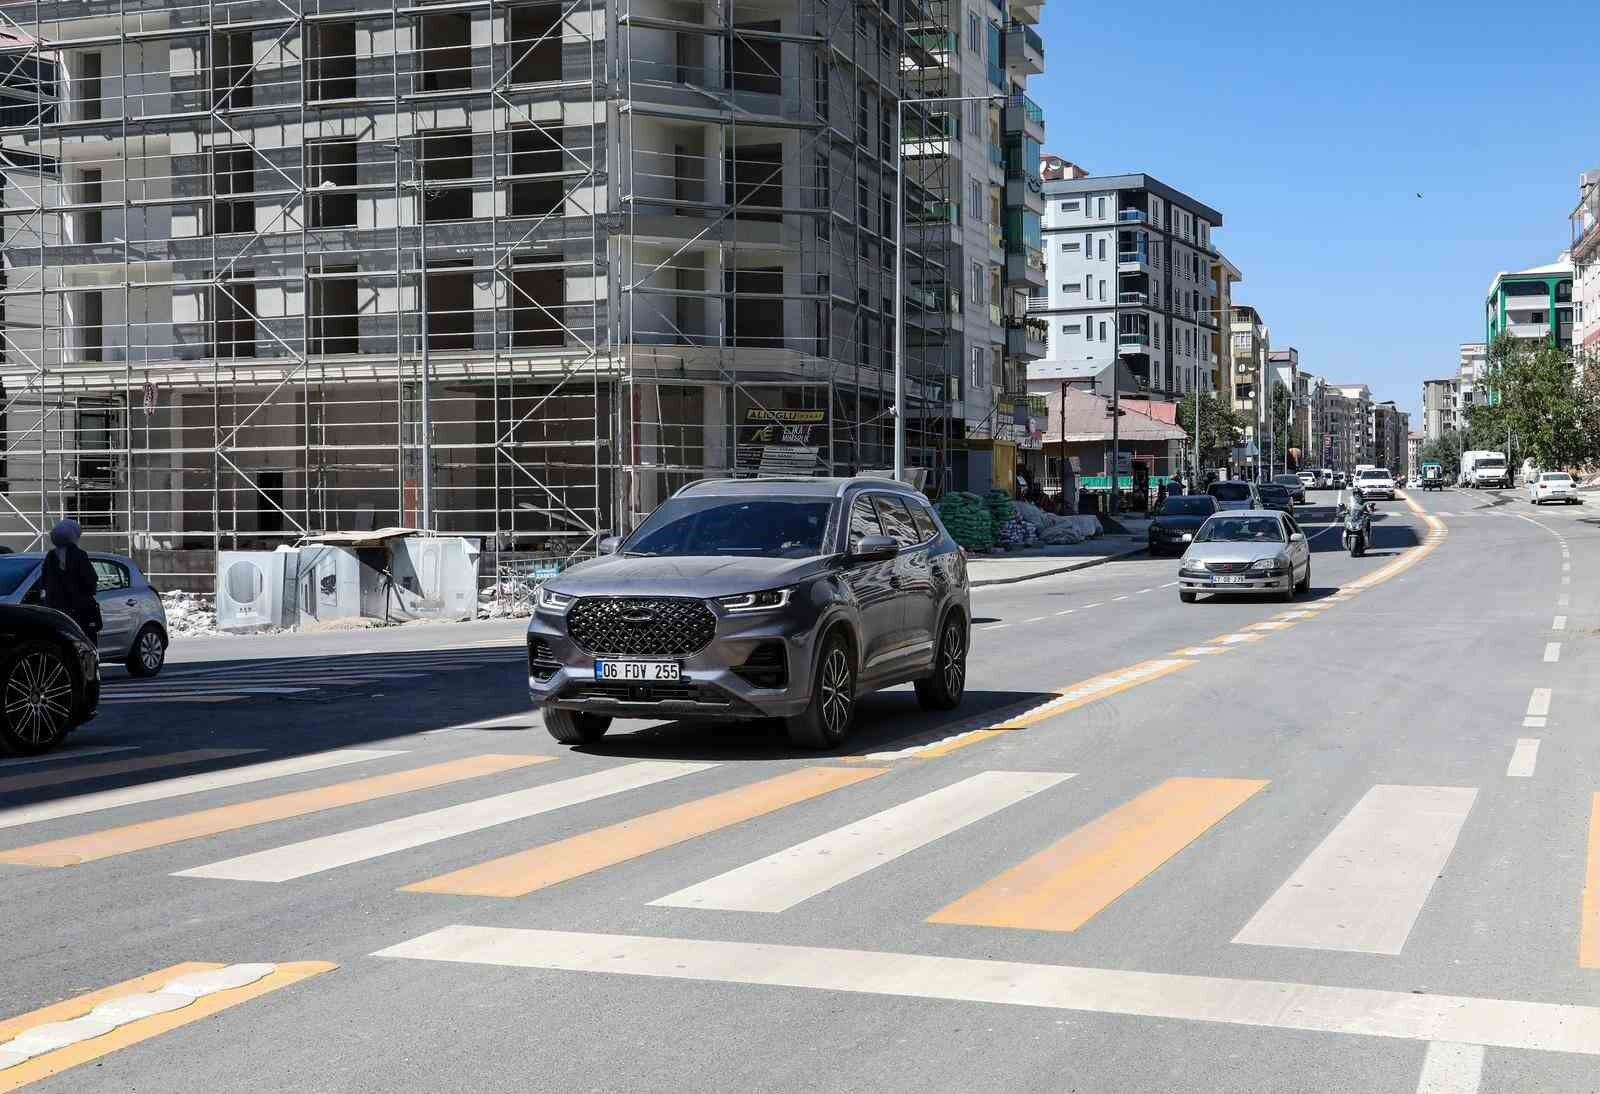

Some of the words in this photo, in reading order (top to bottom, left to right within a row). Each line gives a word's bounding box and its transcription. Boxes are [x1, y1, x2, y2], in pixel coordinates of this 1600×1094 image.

[603, 663, 618, 678] 06
[625, 664, 647, 679] FDV
[655, 664, 678, 679] 255
